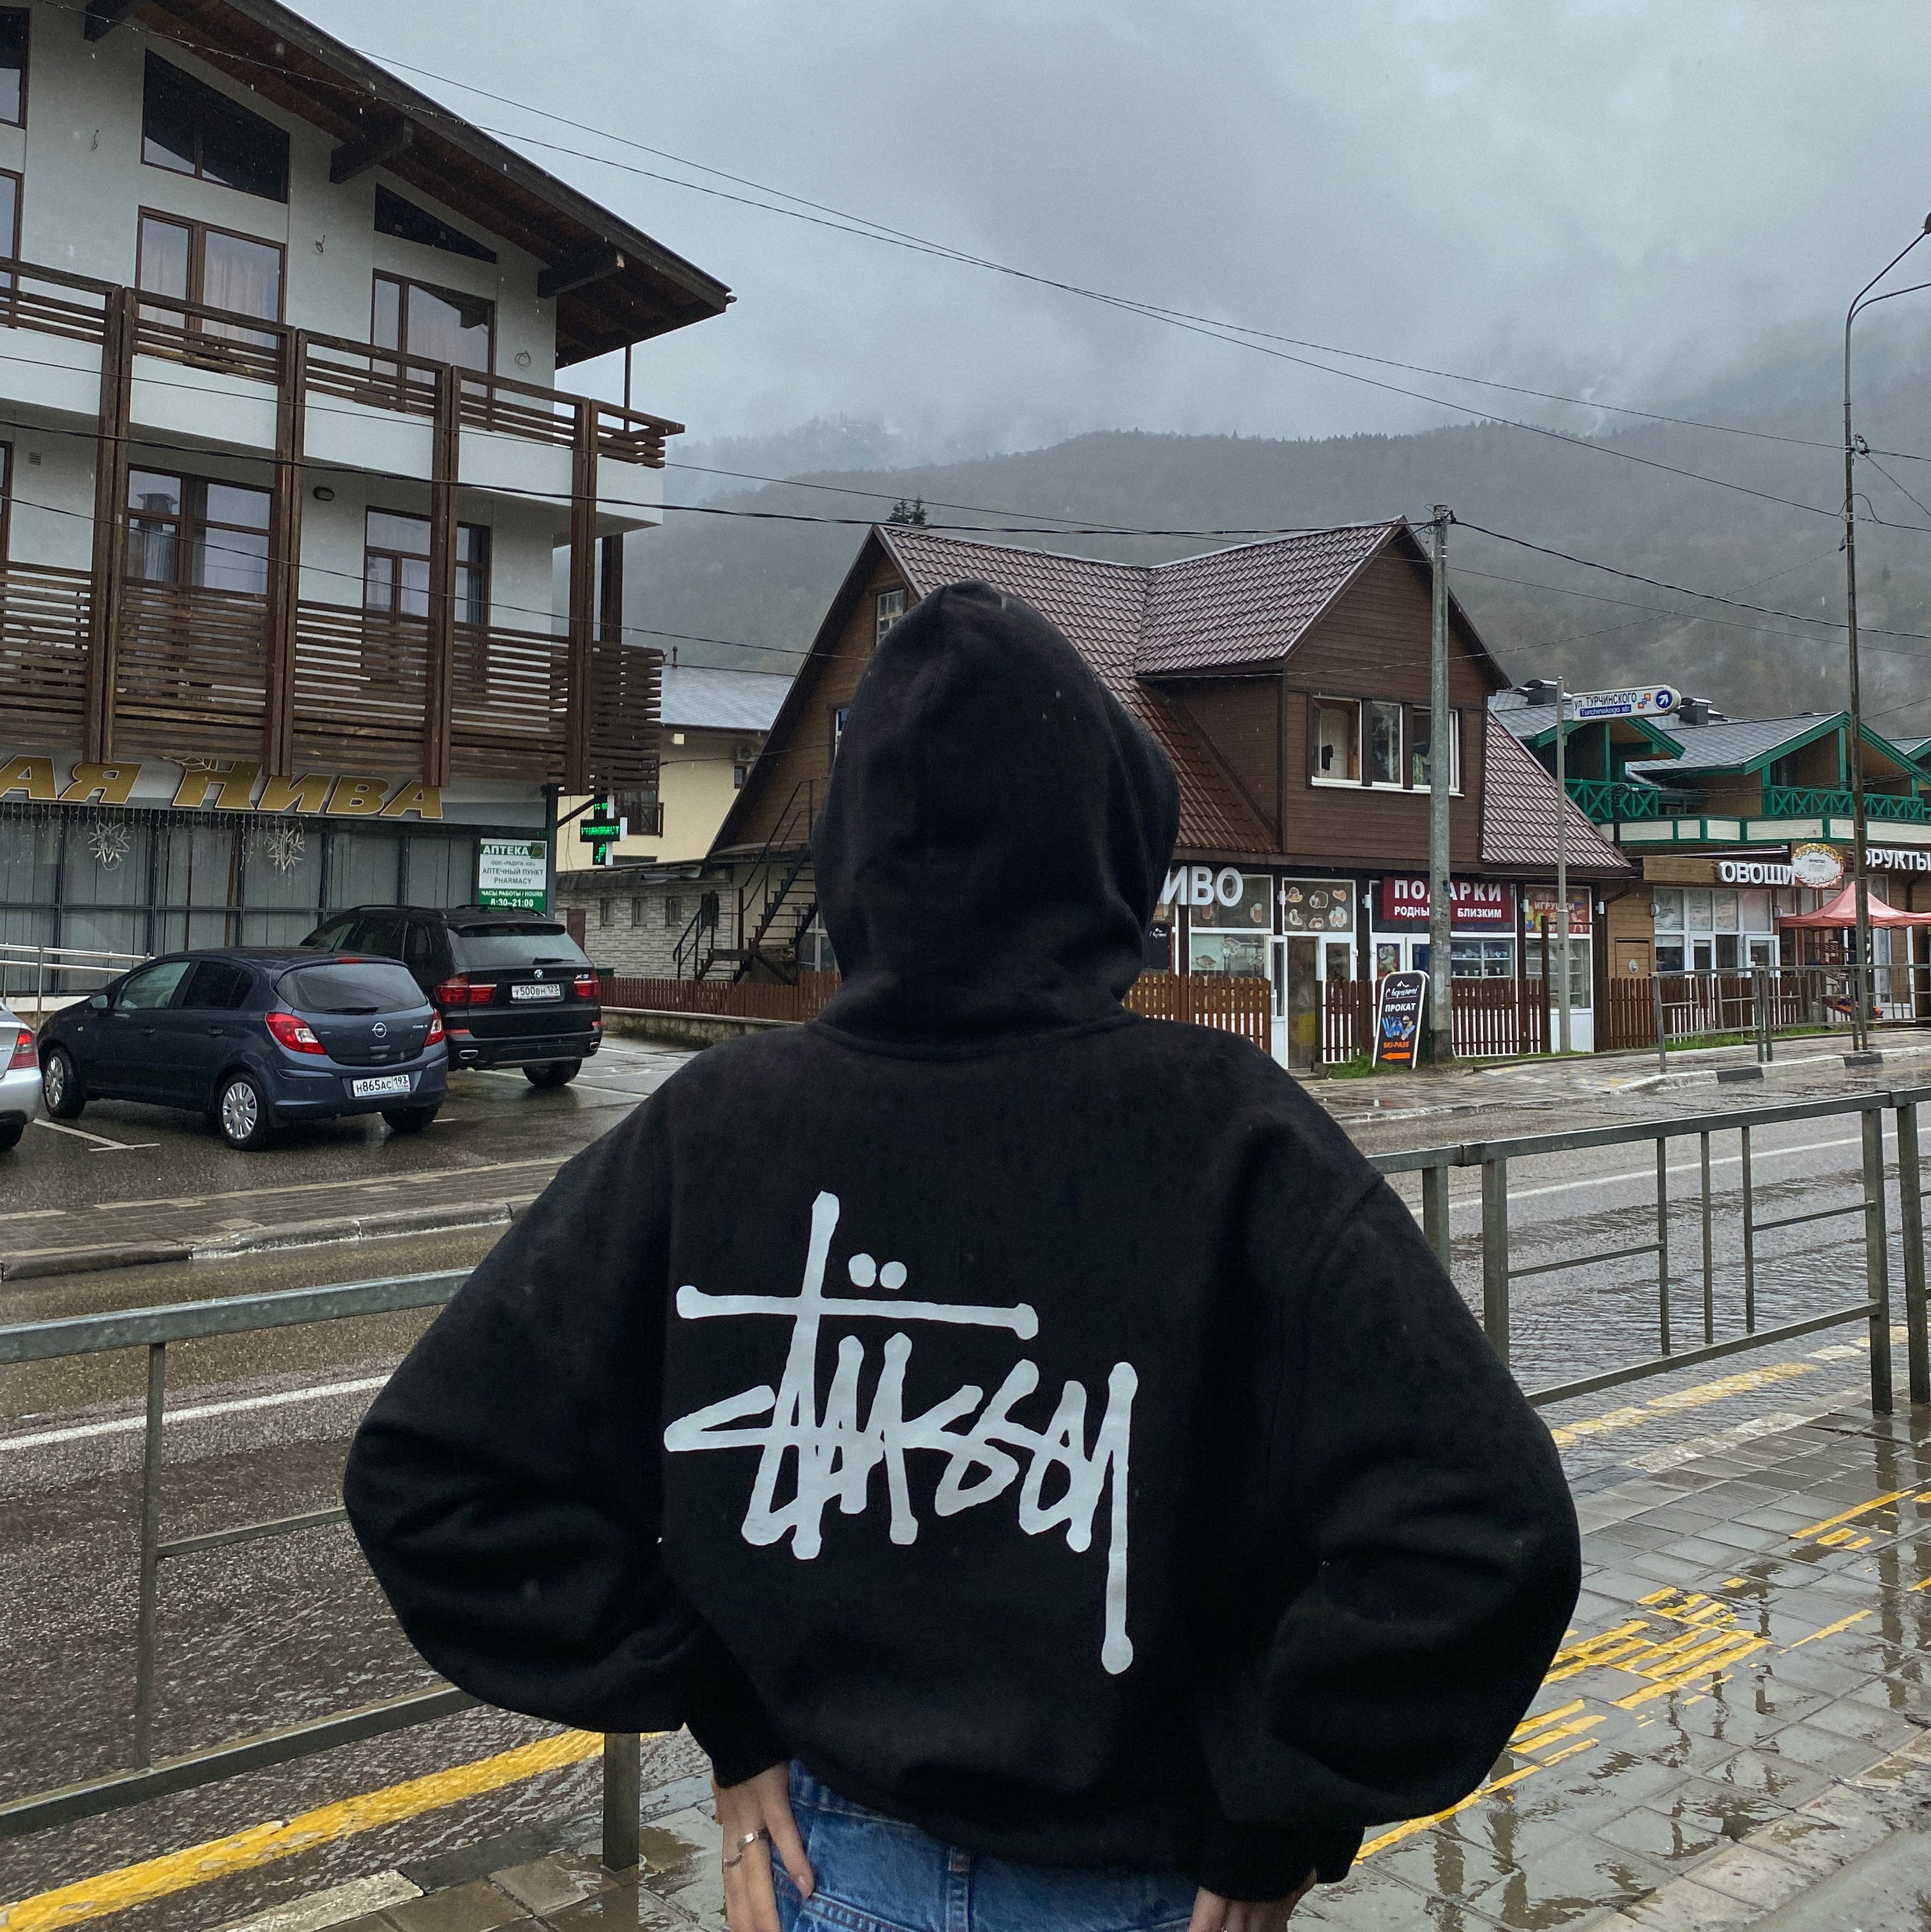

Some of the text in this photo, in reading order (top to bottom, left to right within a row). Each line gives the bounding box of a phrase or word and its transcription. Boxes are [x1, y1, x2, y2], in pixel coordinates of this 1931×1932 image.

[1574, 692, 1637, 710] ул. ТУРЧИНСКОГО
[1581, 706, 1621, 716] Turchinskogo
[0, 754, 443, 819] АЯ НИВА
[482, 845, 529, 856] АПТЕКА
[1159, 866, 1243, 907] ИВО
[1394, 879, 1501, 903] ПОАРКИ
[1394, 906, 1502, 918] РОДНЫ БЛИЗКИМ
[515, 986, 546, 996] У500ВН
[1385, 1003, 1416, 1012] ПРОКАТ
[356, 1076, 408, 1093] Н865АС 193
